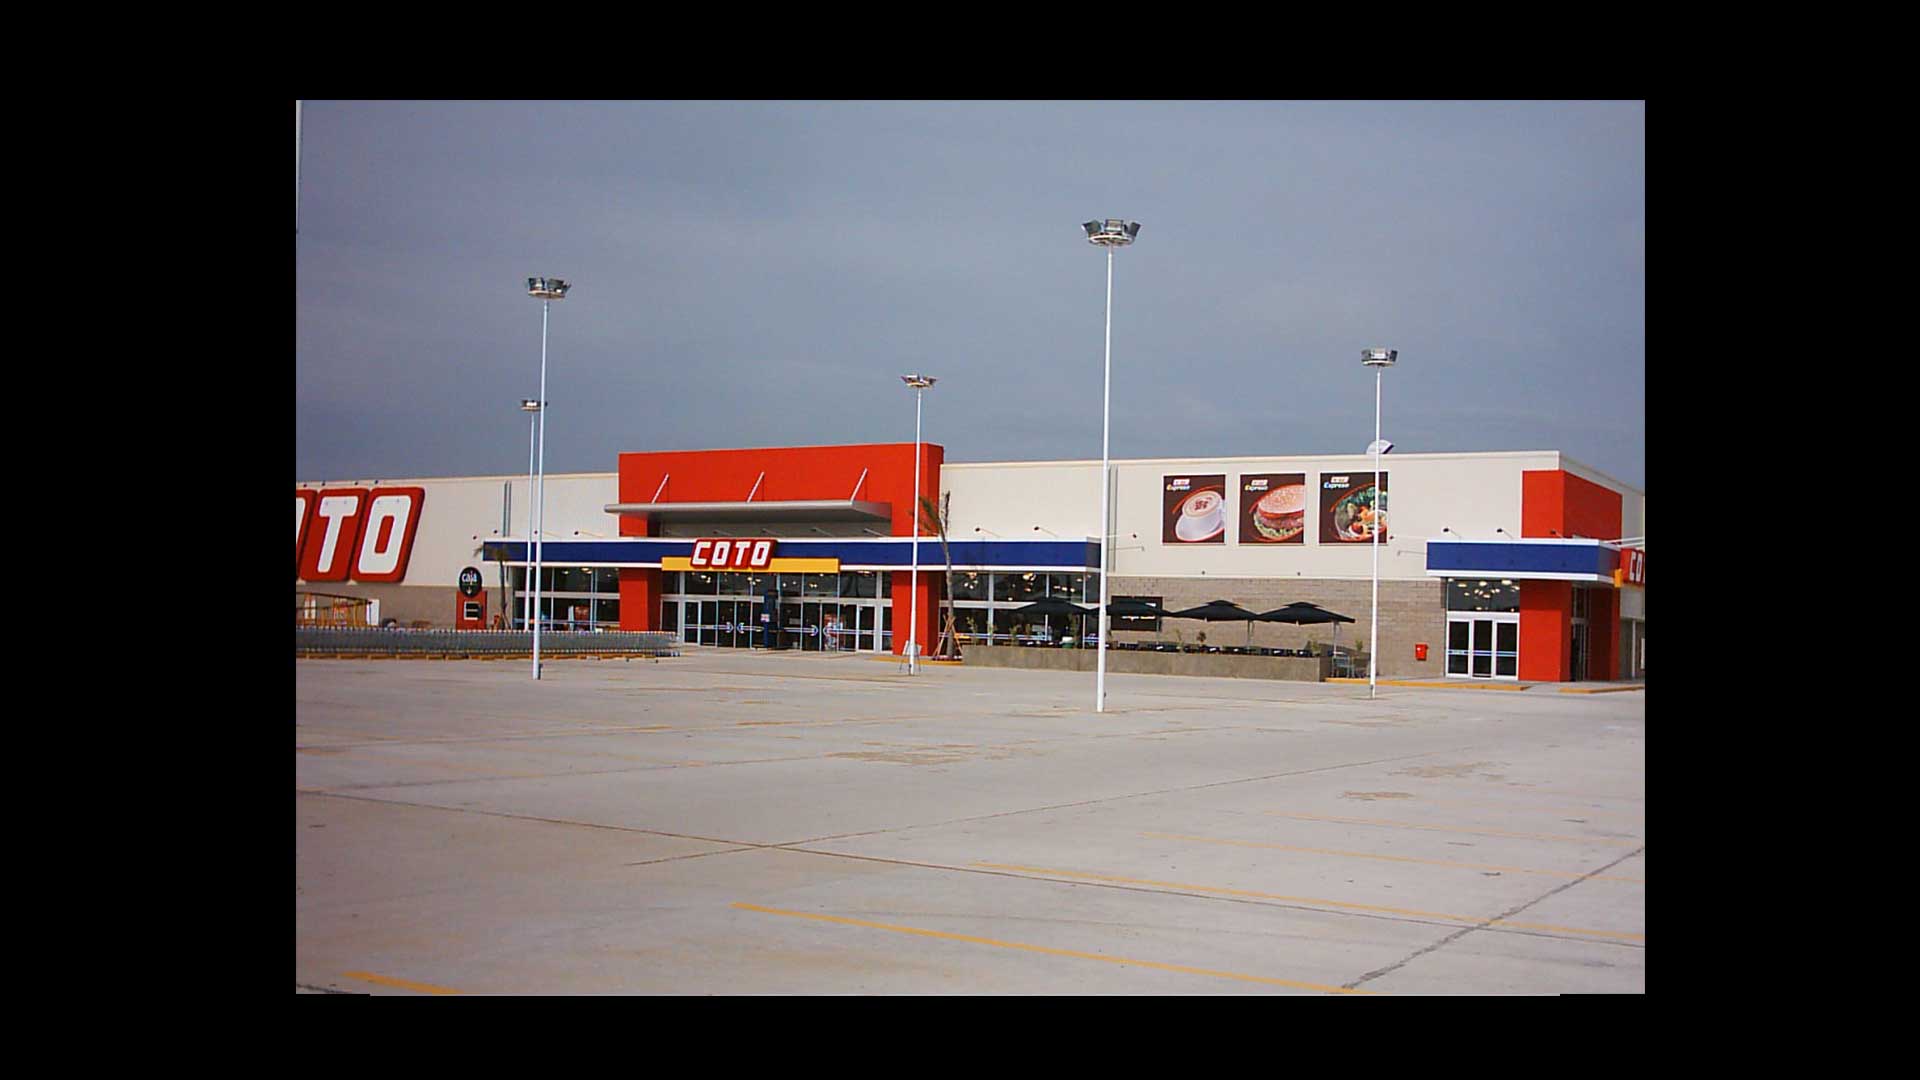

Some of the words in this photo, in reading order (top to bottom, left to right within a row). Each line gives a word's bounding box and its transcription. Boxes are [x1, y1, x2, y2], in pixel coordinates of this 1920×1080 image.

[296, 496, 411, 573] TO
[692, 541, 771, 566] COTO
[1629, 551, 1645, 583] CO
